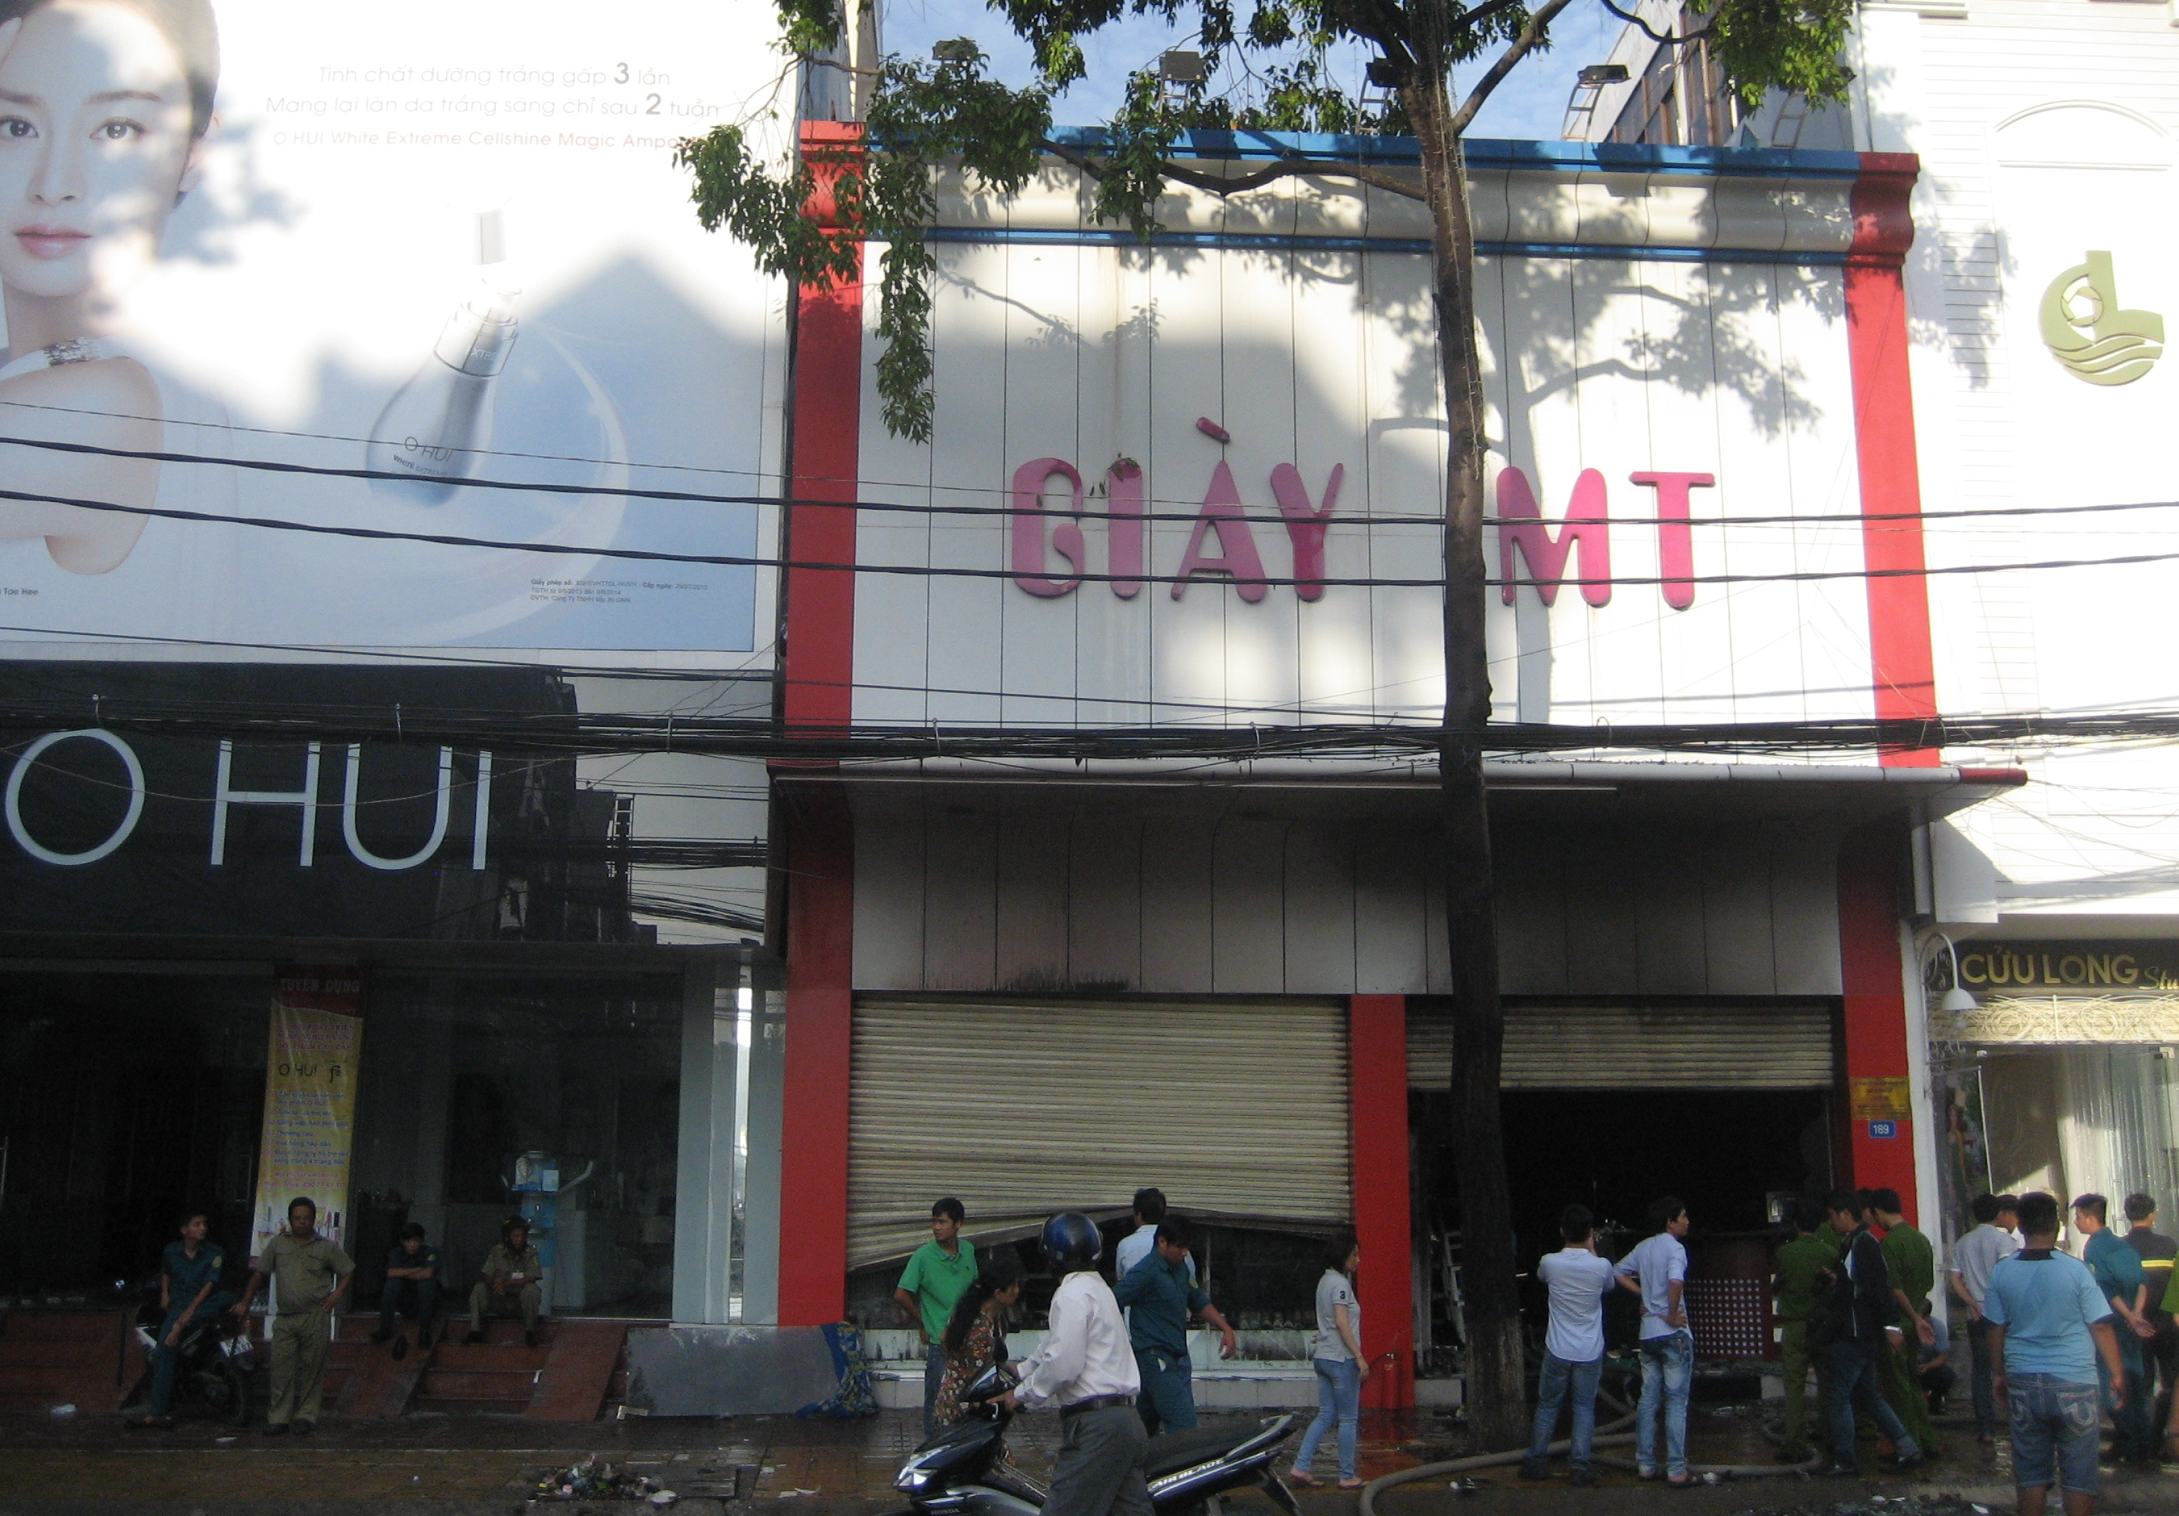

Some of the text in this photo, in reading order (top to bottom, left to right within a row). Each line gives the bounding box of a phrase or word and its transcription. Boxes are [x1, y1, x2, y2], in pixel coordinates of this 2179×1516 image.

[614, 61, 630, 84] 3
[266, 97, 327, 117] Mang
[405, 97, 433, 113] da
[600, 101, 638, 115] sau
[645, 93, 662, 115] 2
[273, 131, 288, 145] O
[293, 131, 324, 145] HUI
[331, 131, 380, 145] White
[386, 131, 463, 146] Extreme
[468, 131, 551, 147] Cellshine
[558, 132, 615, 151] Magic
[1011, 417, 1715, 611] GIÀY MT
[5, 727, 492, 870] O HUI
[2043, 952, 2140, 984] LONG
[1339, 1290, 1346, 1300] 3
